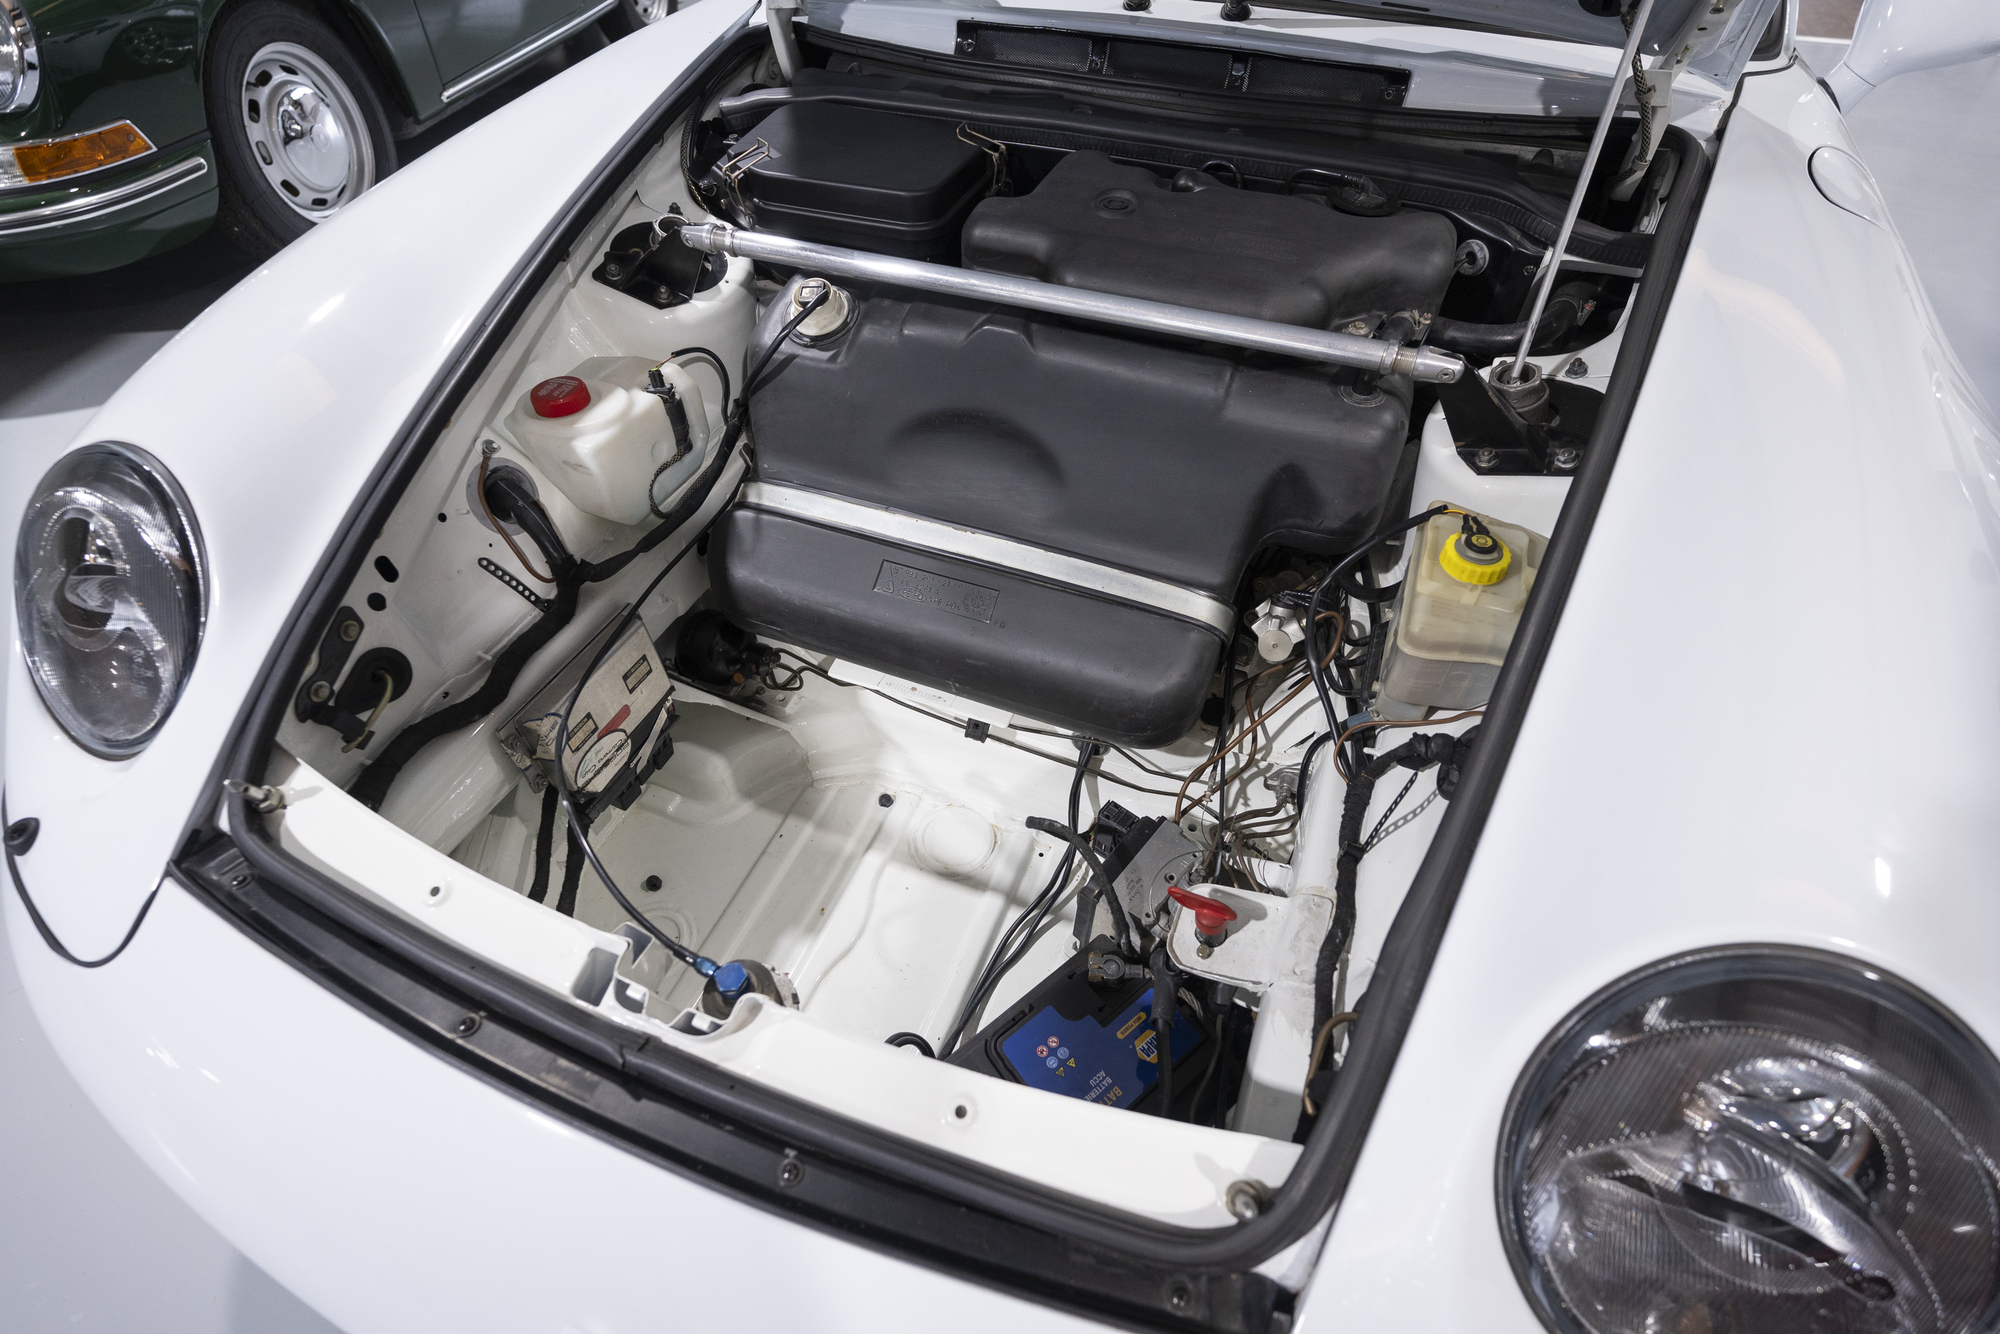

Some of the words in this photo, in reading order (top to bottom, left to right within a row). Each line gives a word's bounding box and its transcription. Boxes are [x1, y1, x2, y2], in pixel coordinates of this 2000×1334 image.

[573, 717, 588, 732] BOSCH
[1121, 1022, 1135, 1036] POWER
[1089, 1070, 1106, 1087] ACCU
[1084, 1076, 1113, 1102] BATTERIE
